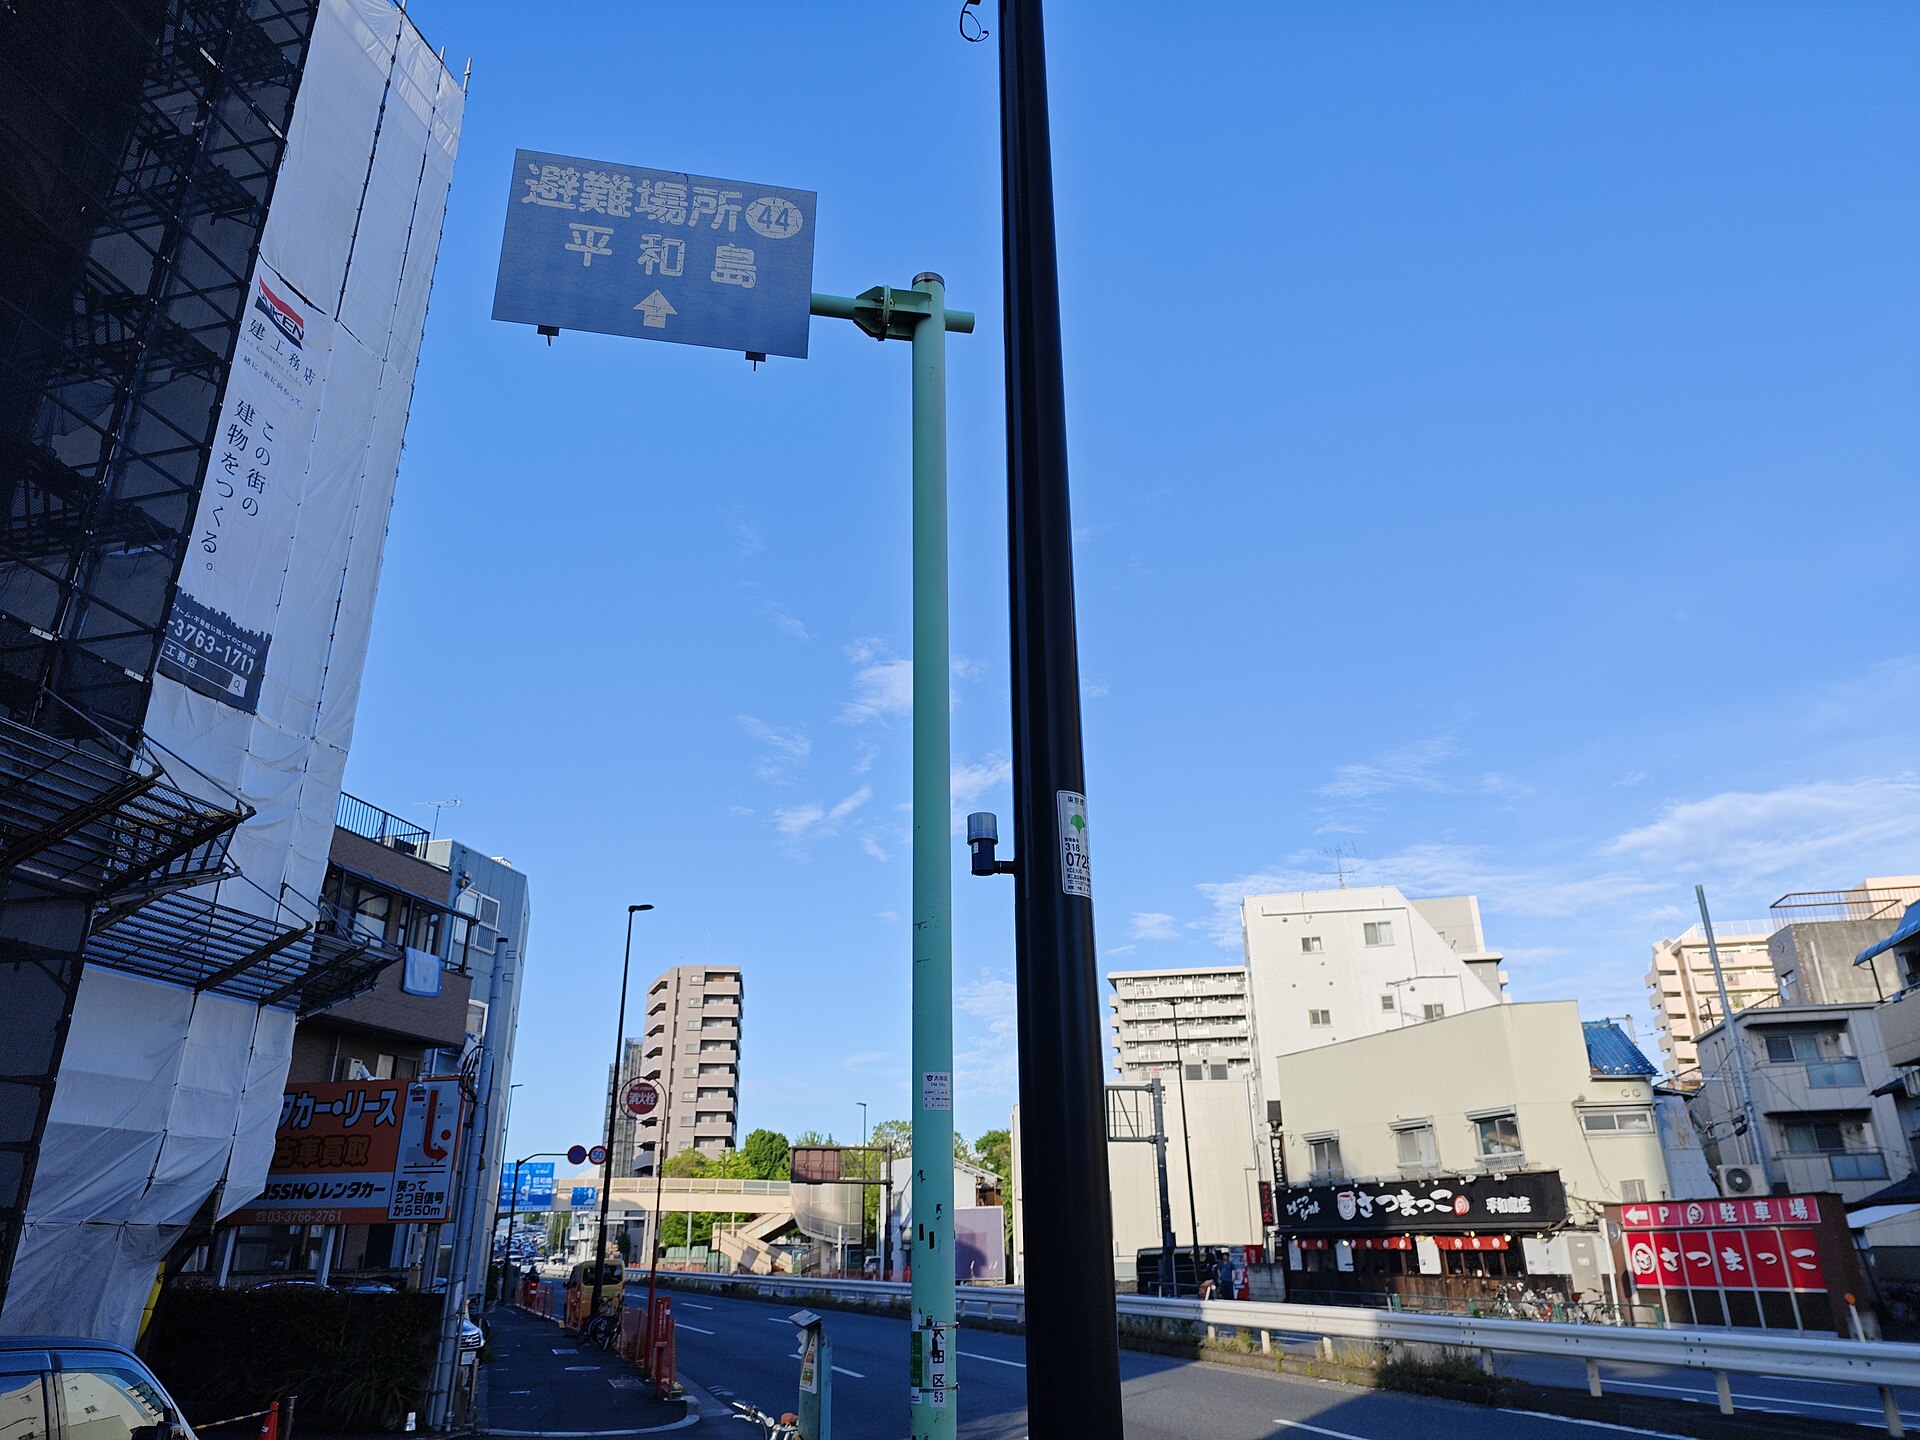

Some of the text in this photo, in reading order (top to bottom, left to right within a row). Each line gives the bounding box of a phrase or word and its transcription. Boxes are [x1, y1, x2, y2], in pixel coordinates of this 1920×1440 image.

[521, 163, 790, 233] 避難場所 44
[564, 223, 757, 289] 平和島
[242, 420, 274, 518] この街の
[201, 400, 256, 572] 建物をつくる。
[165, 644, 198, 669] 工務店
[1065, 843, 1080, 852] 318
[628, 1092, 655, 1106] 消火栓
[592, 1150, 603, 1160] 50
[397, 1180, 427, 1192] 戻って
[395, 1192, 445, 1204] 2つ目信号
[1356, 1189, 1453, 1218] さつまっこ
[1486, 1196, 1532, 1214] 平和島店
[393, 1205, 440, 1217] から50m
[1719, 1198, 1809, 1223] 駐車場
[1660, 1246, 1817, 1272] さつまっこ
[934, 1392, 944, 1403] 53
